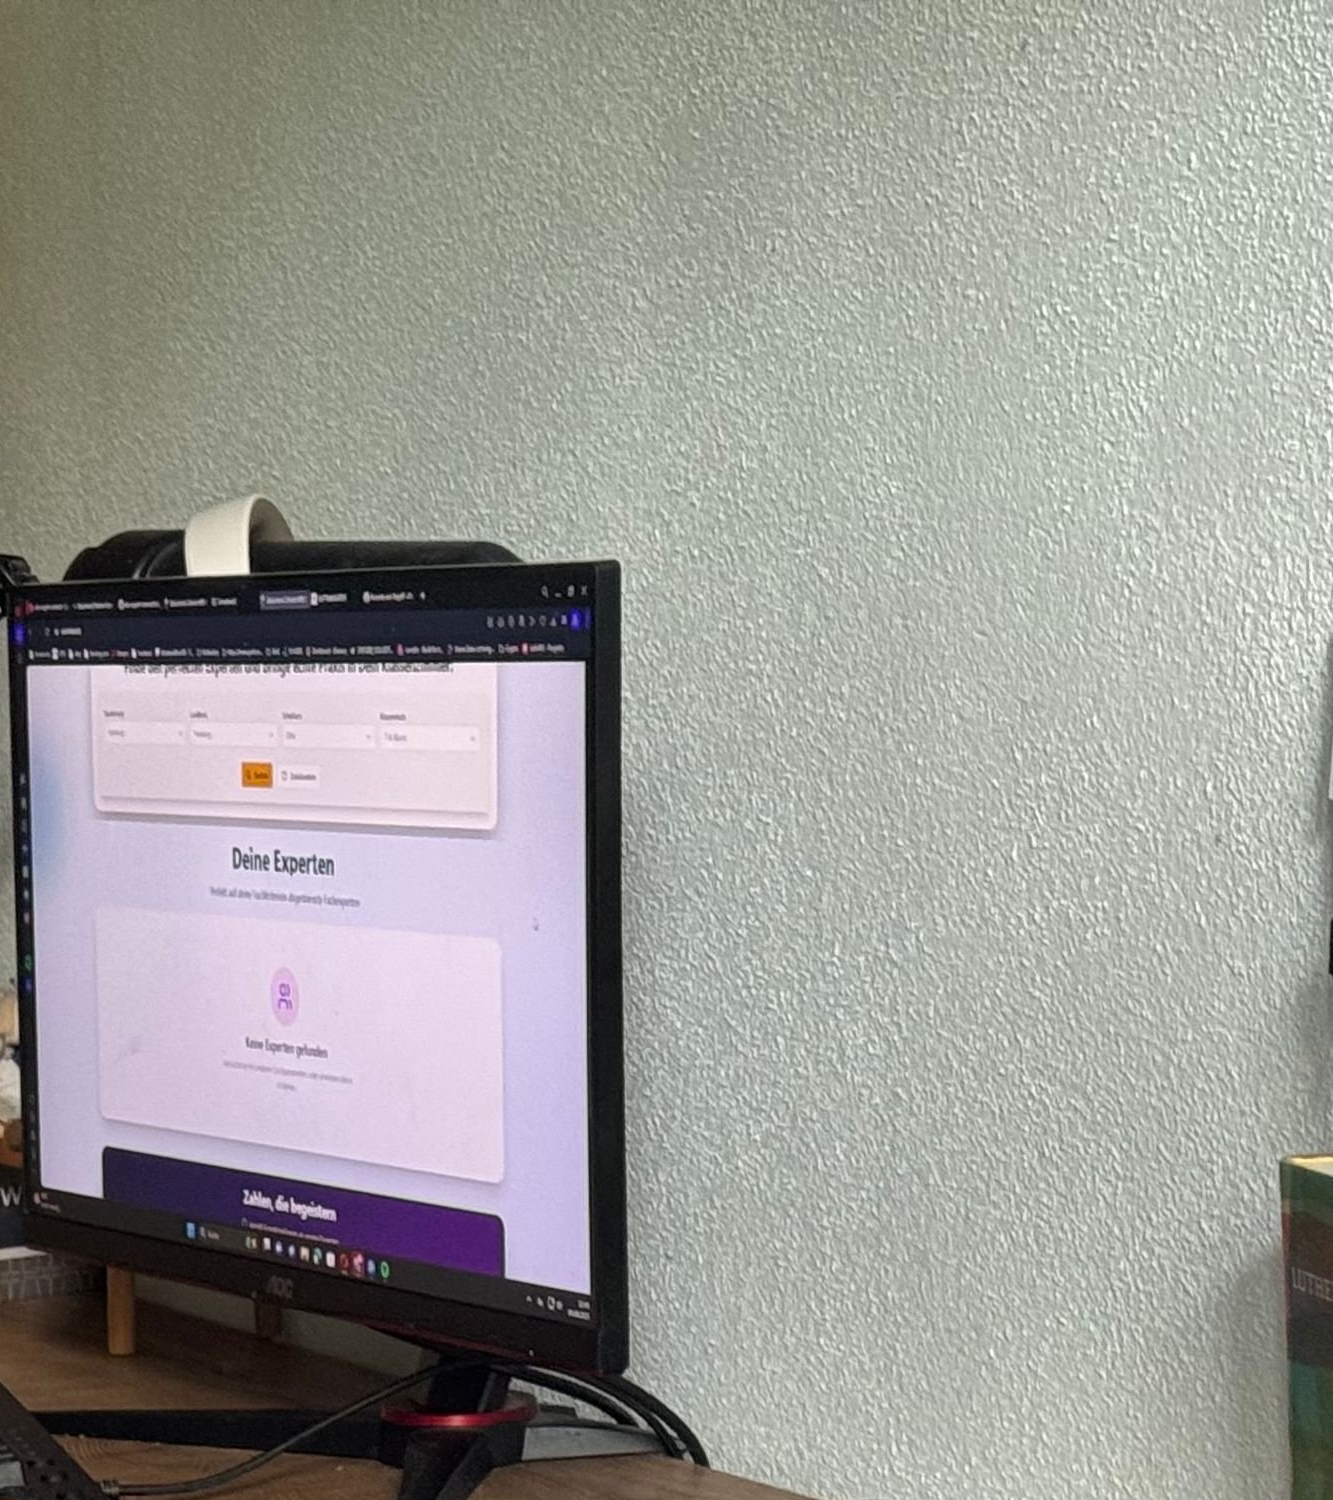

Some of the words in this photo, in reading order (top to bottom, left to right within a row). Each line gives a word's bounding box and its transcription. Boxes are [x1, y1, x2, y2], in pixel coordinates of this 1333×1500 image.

[232, 847, 270, 872] Deine
[274, 849, 335, 876] Experten
[265, 1039, 295, 1055] Experten
[242, 1189, 273, 1212] Zahlen,
[275, 1194, 290, 1214] die
[291, 1197, 337, 1222] begeistern
